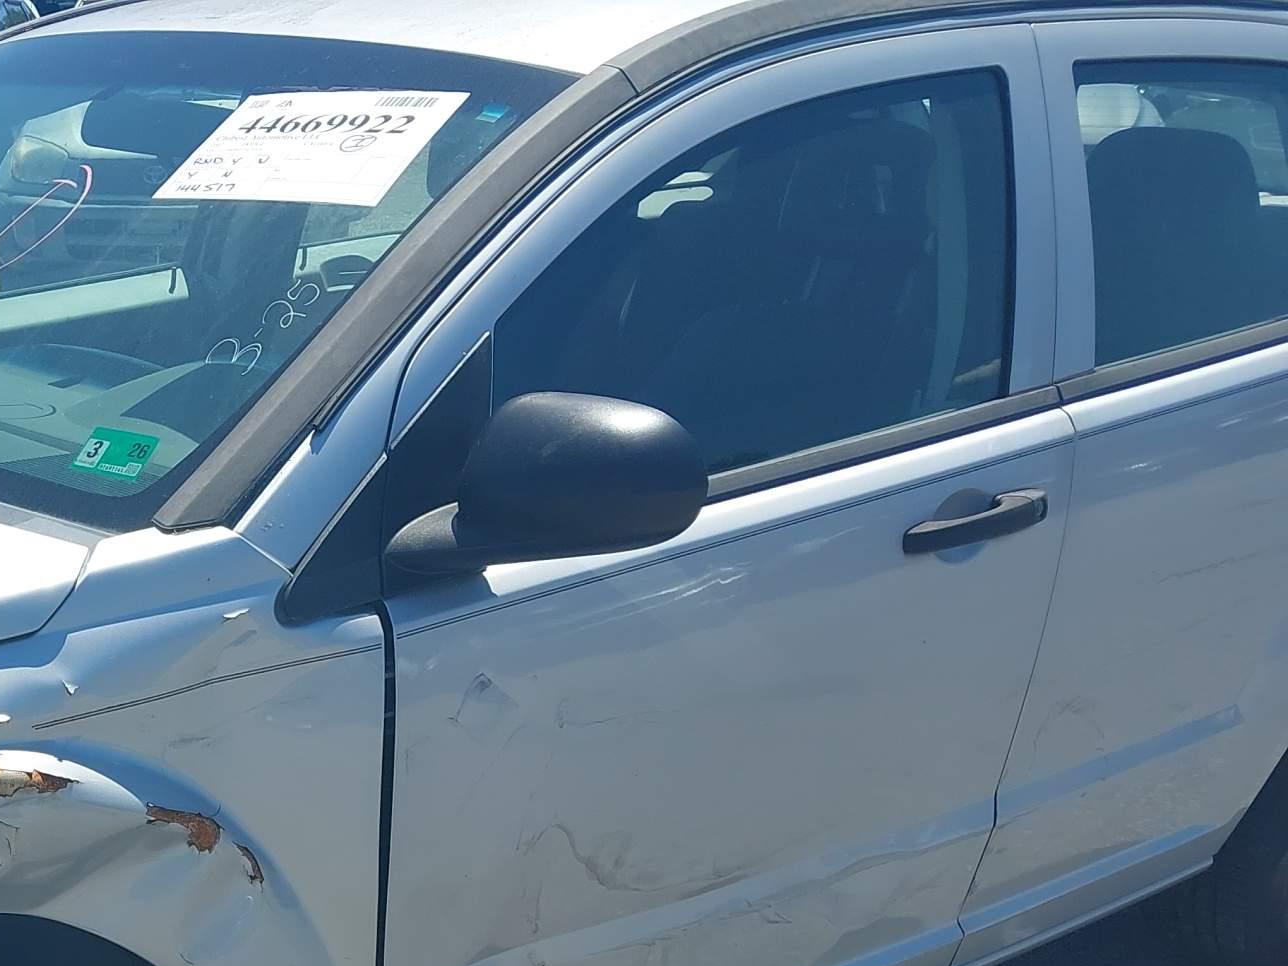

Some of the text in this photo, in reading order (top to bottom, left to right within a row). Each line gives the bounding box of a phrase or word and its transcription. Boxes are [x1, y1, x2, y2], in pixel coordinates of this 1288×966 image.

[238, 113, 416, 134] 44669922
[86, 440, 151, 460] 3 26
